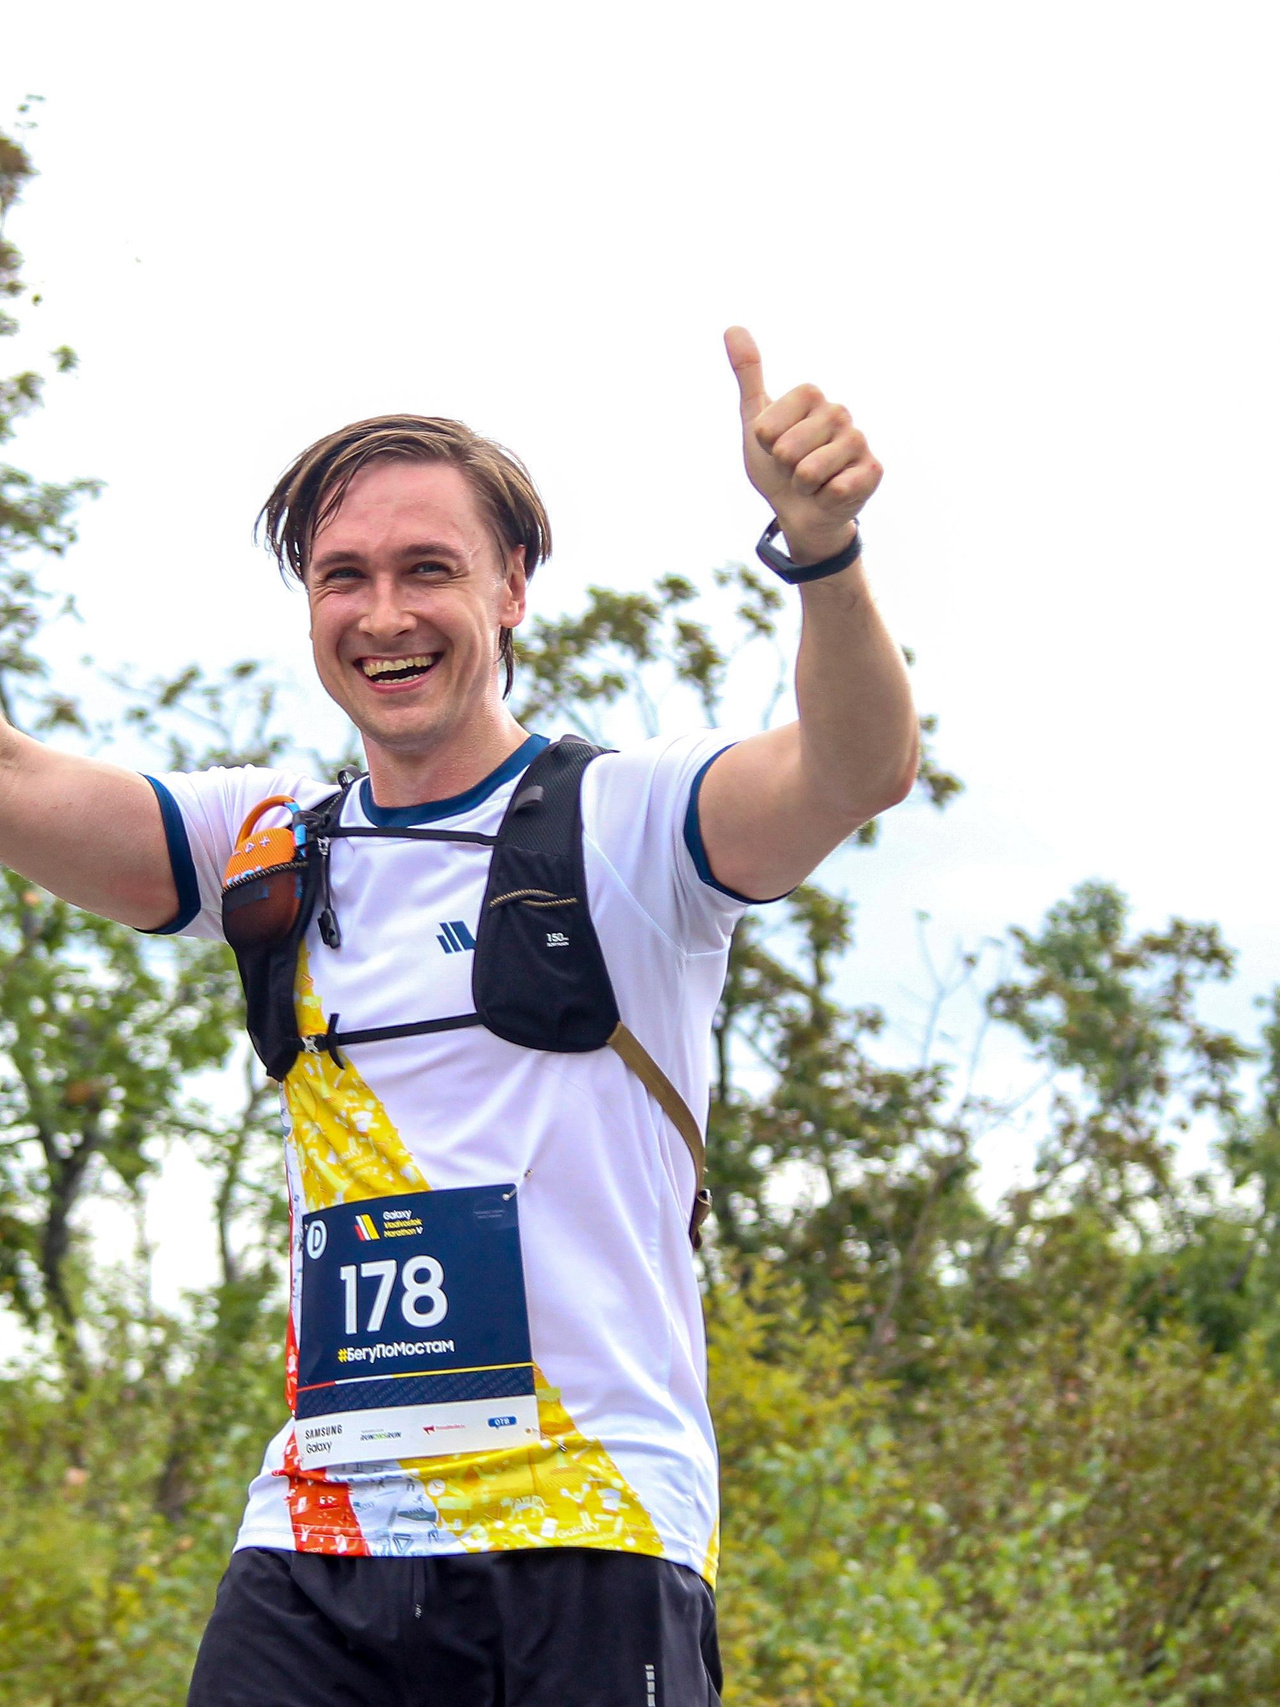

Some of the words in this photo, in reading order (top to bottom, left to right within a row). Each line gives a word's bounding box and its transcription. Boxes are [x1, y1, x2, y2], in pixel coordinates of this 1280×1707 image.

[382, 1210, 412, 1220] Galaxy
[340, 1255, 448, 1335] 178
[337, 1340, 455, 1363] #БегуПоМостам
[305, 1425, 343, 1440] SAMSUNG
[306, 1441, 332, 1454] Galaxy
